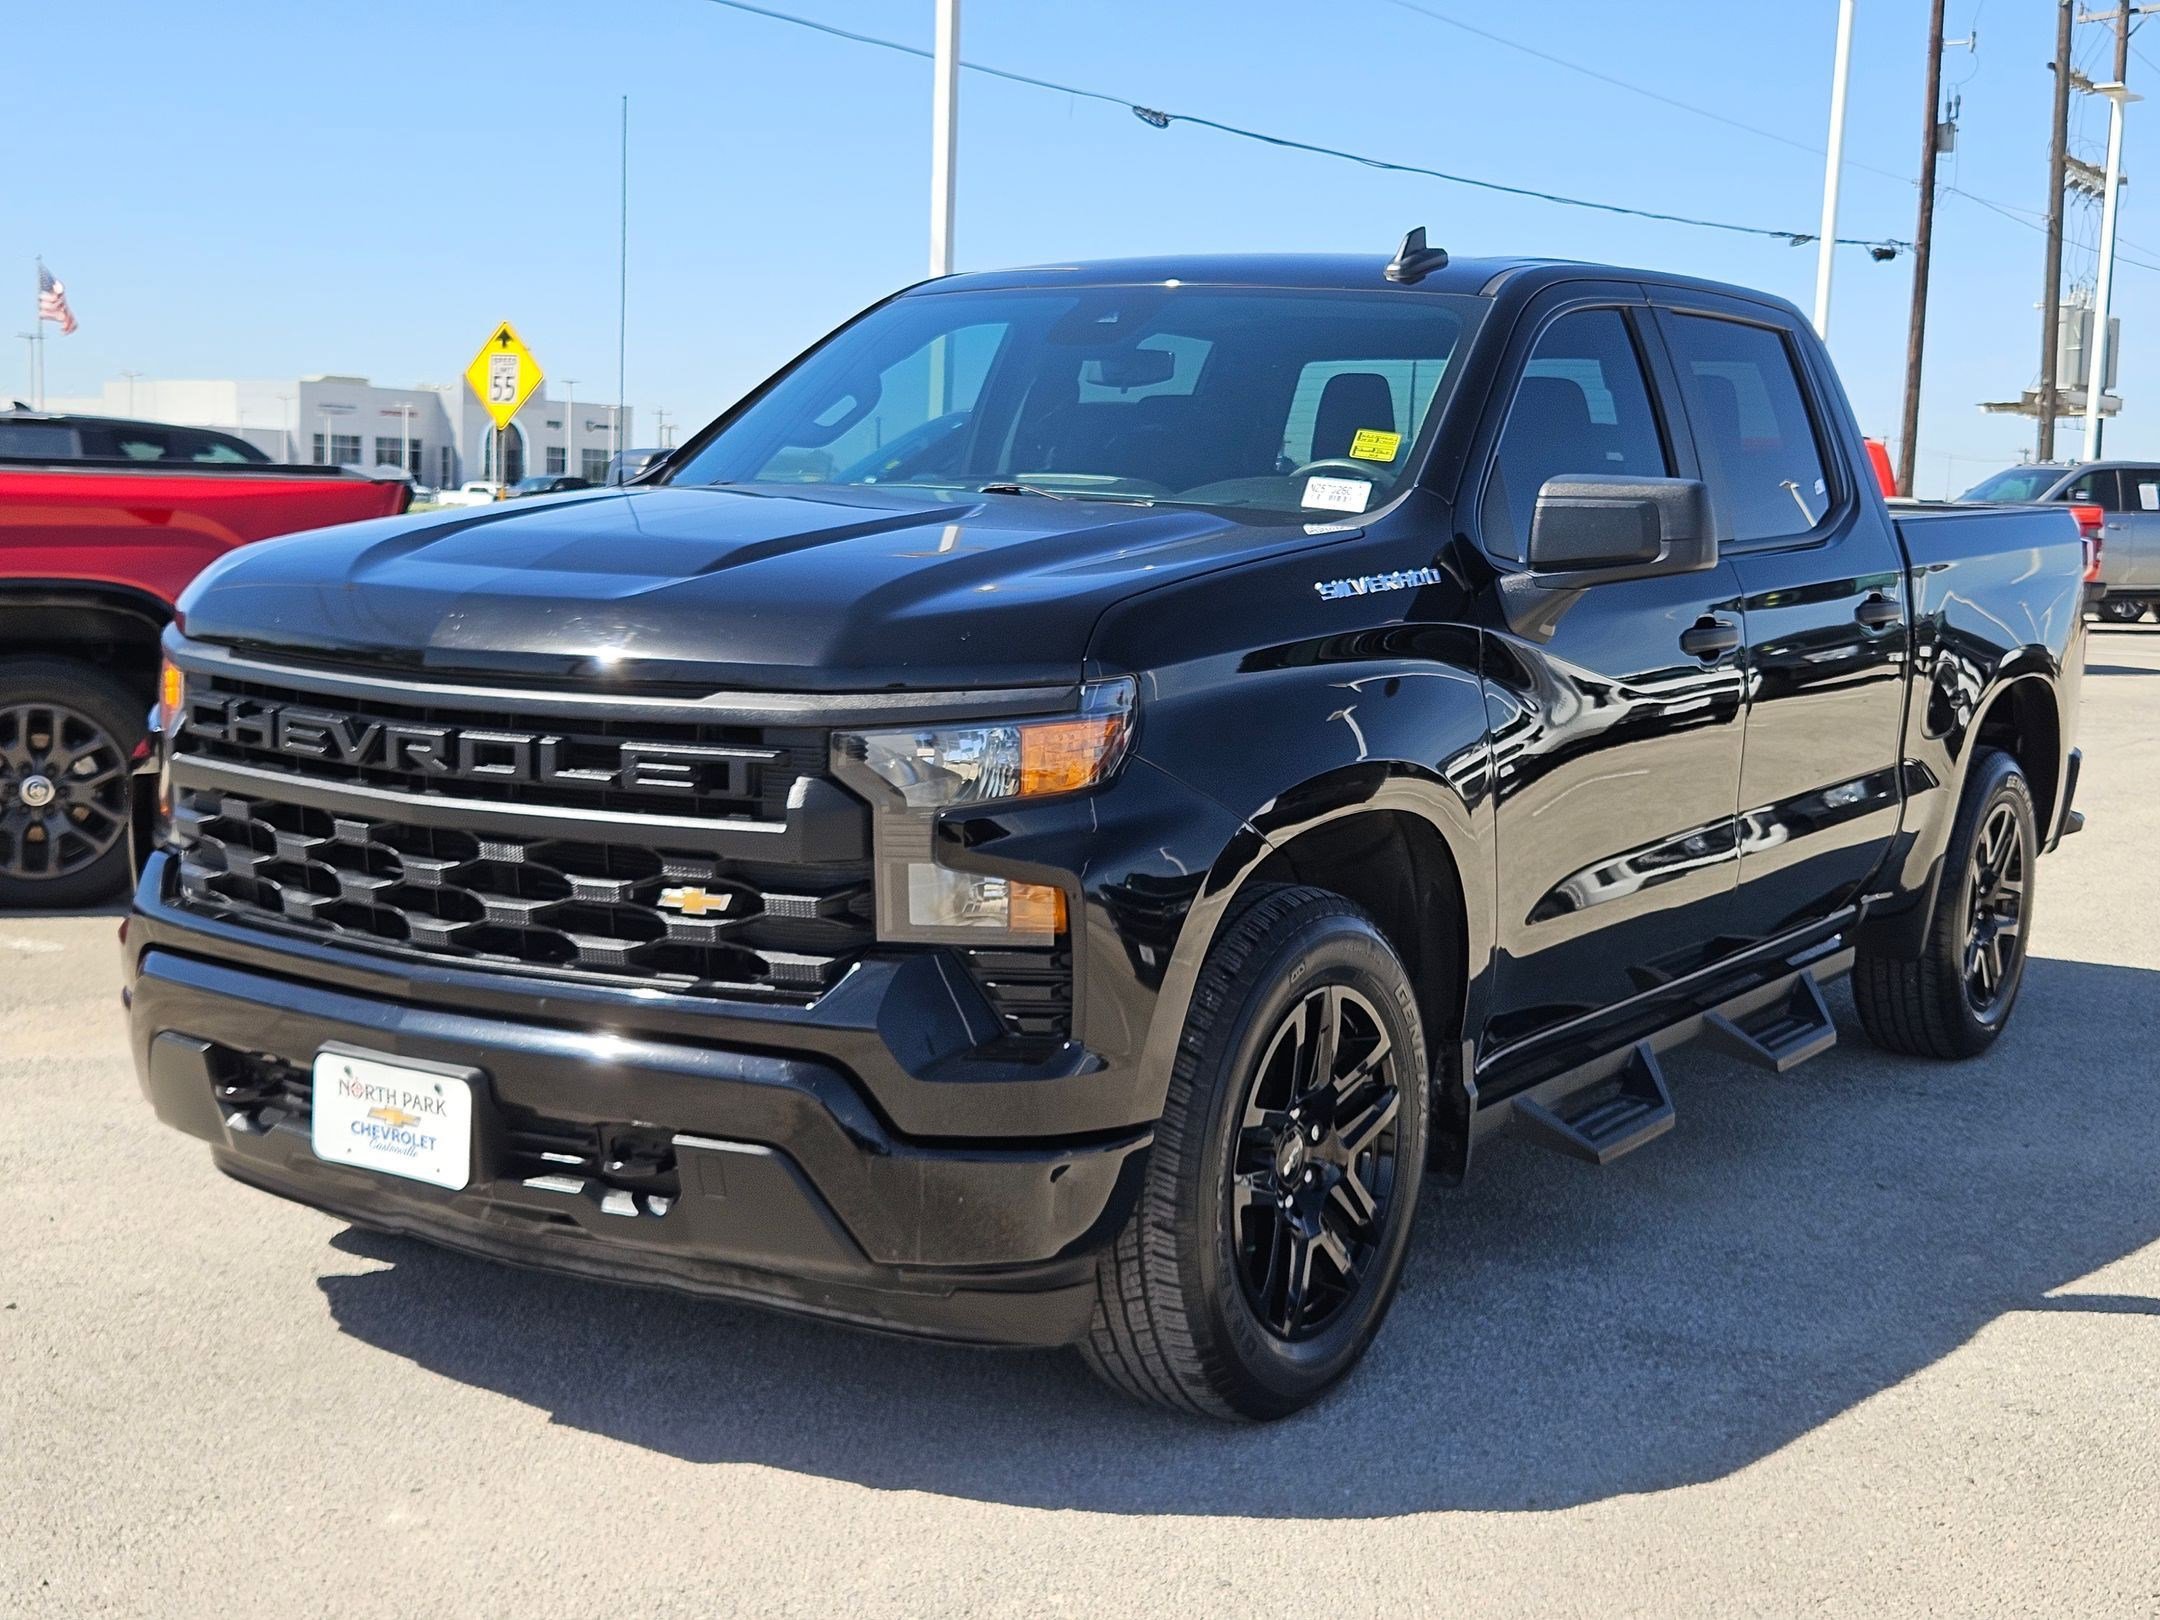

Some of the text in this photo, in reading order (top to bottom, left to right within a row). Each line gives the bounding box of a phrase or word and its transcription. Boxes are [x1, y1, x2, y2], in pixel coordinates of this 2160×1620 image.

[492, 375, 515, 401] 55
[1315, 567, 1441, 600] SILVERADO
[186, 694, 793, 798] CHEVROLET
[339, 1078, 448, 1117] NORTH PARK
[351, 1120, 437, 1150] CHEVROLET
